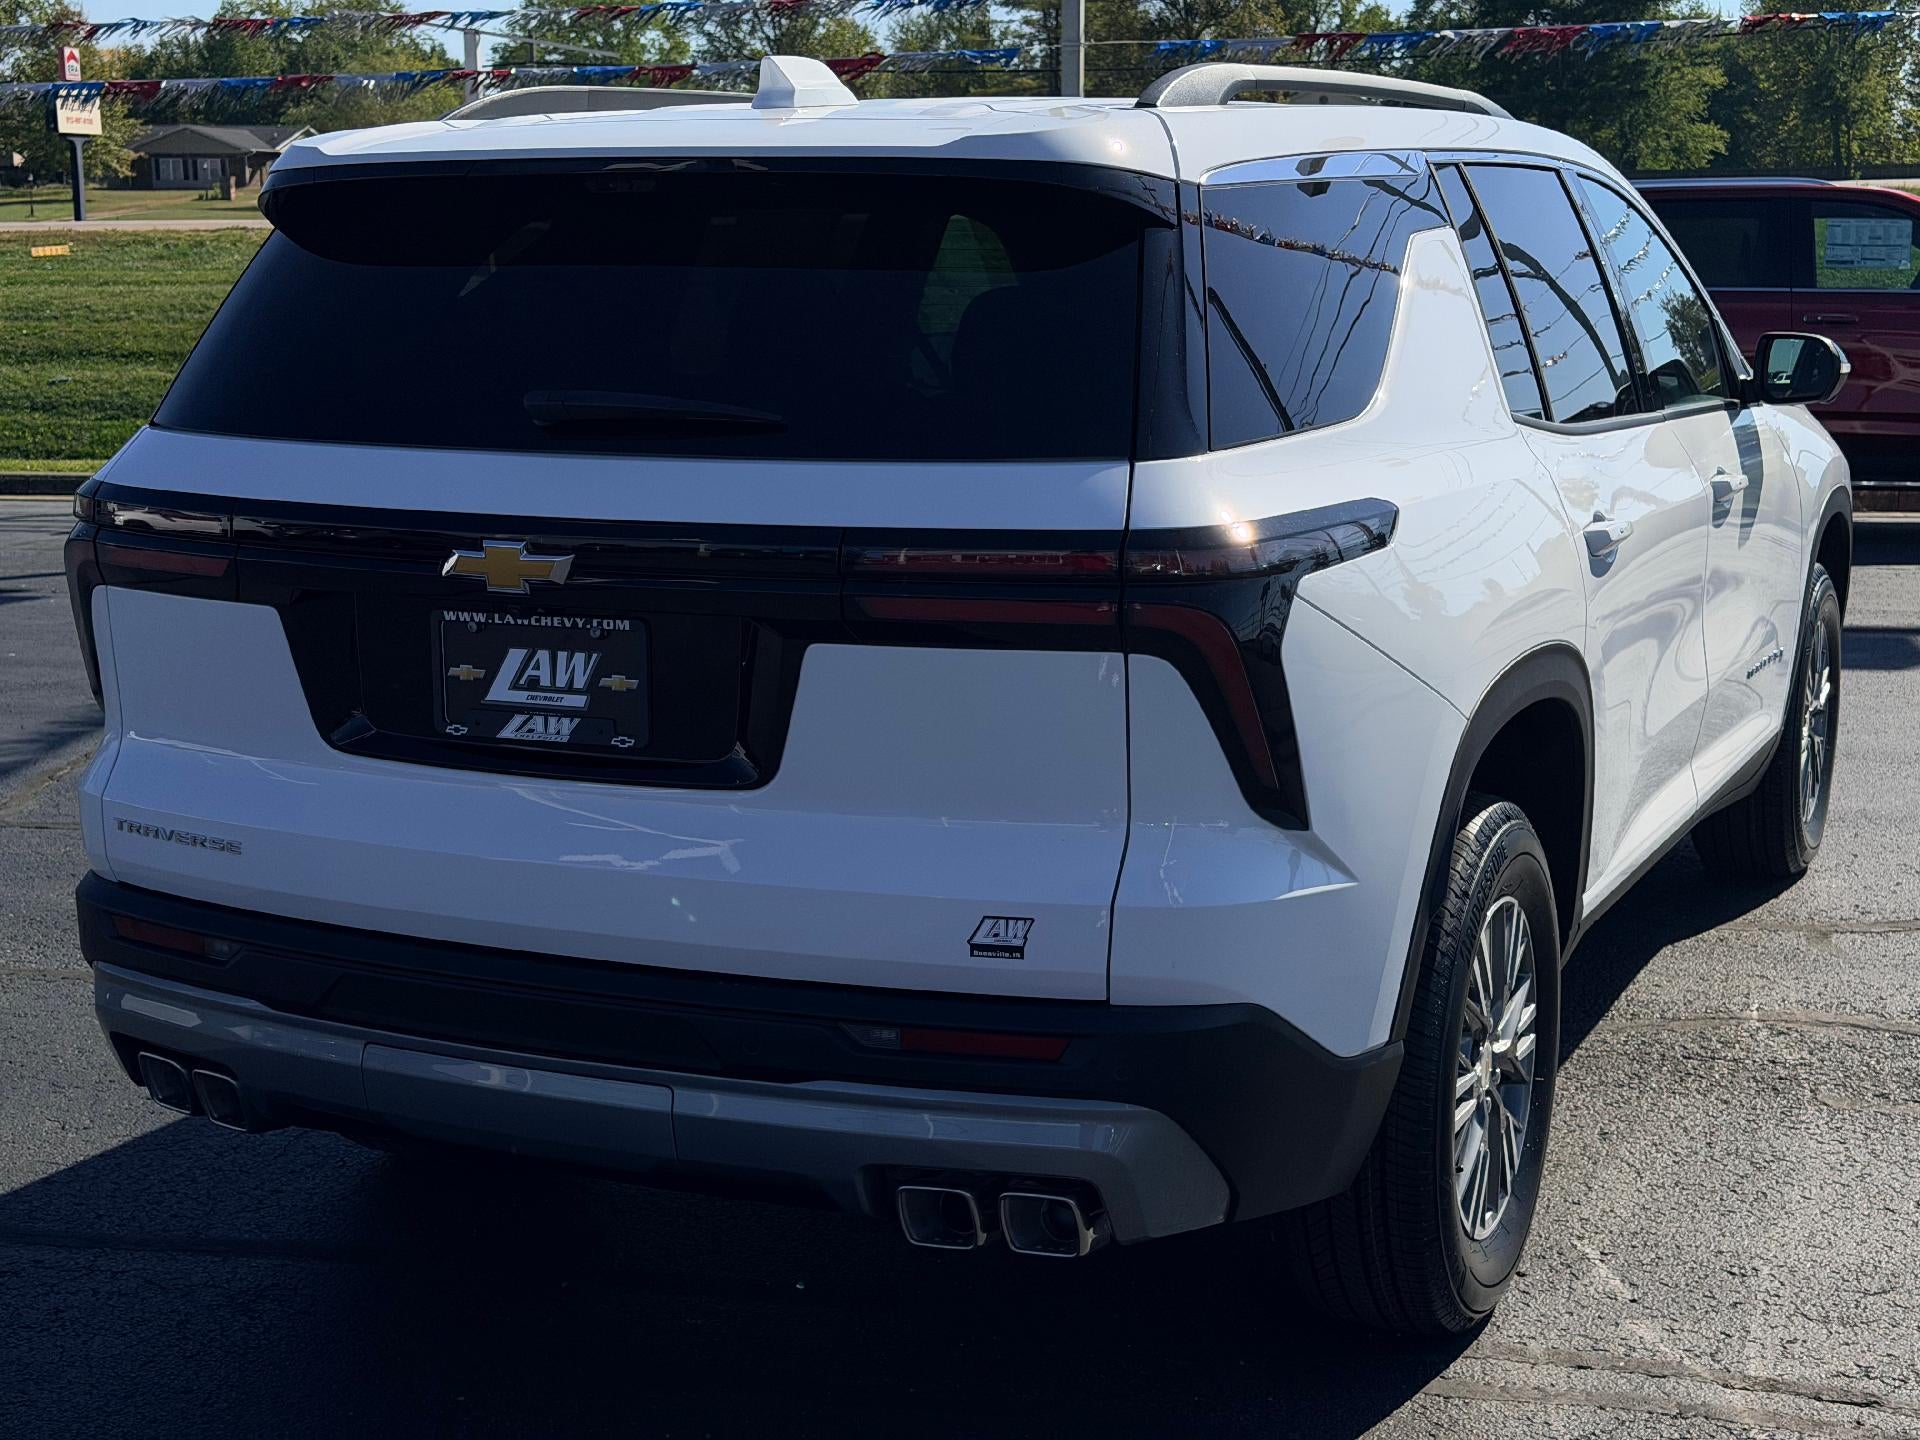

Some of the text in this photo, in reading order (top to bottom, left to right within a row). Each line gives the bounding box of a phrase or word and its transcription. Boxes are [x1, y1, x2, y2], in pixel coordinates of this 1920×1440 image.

[443, 610, 631, 631] WWW.LAWCHEVY.COM
[484, 648, 599, 708] LAW
[526, 694, 565, 704] CHEVROLET
[496, 714, 581, 743] LAW
[113, 818, 243, 856] TRAVERSE
[969, 917, 1033, 946] LAW
